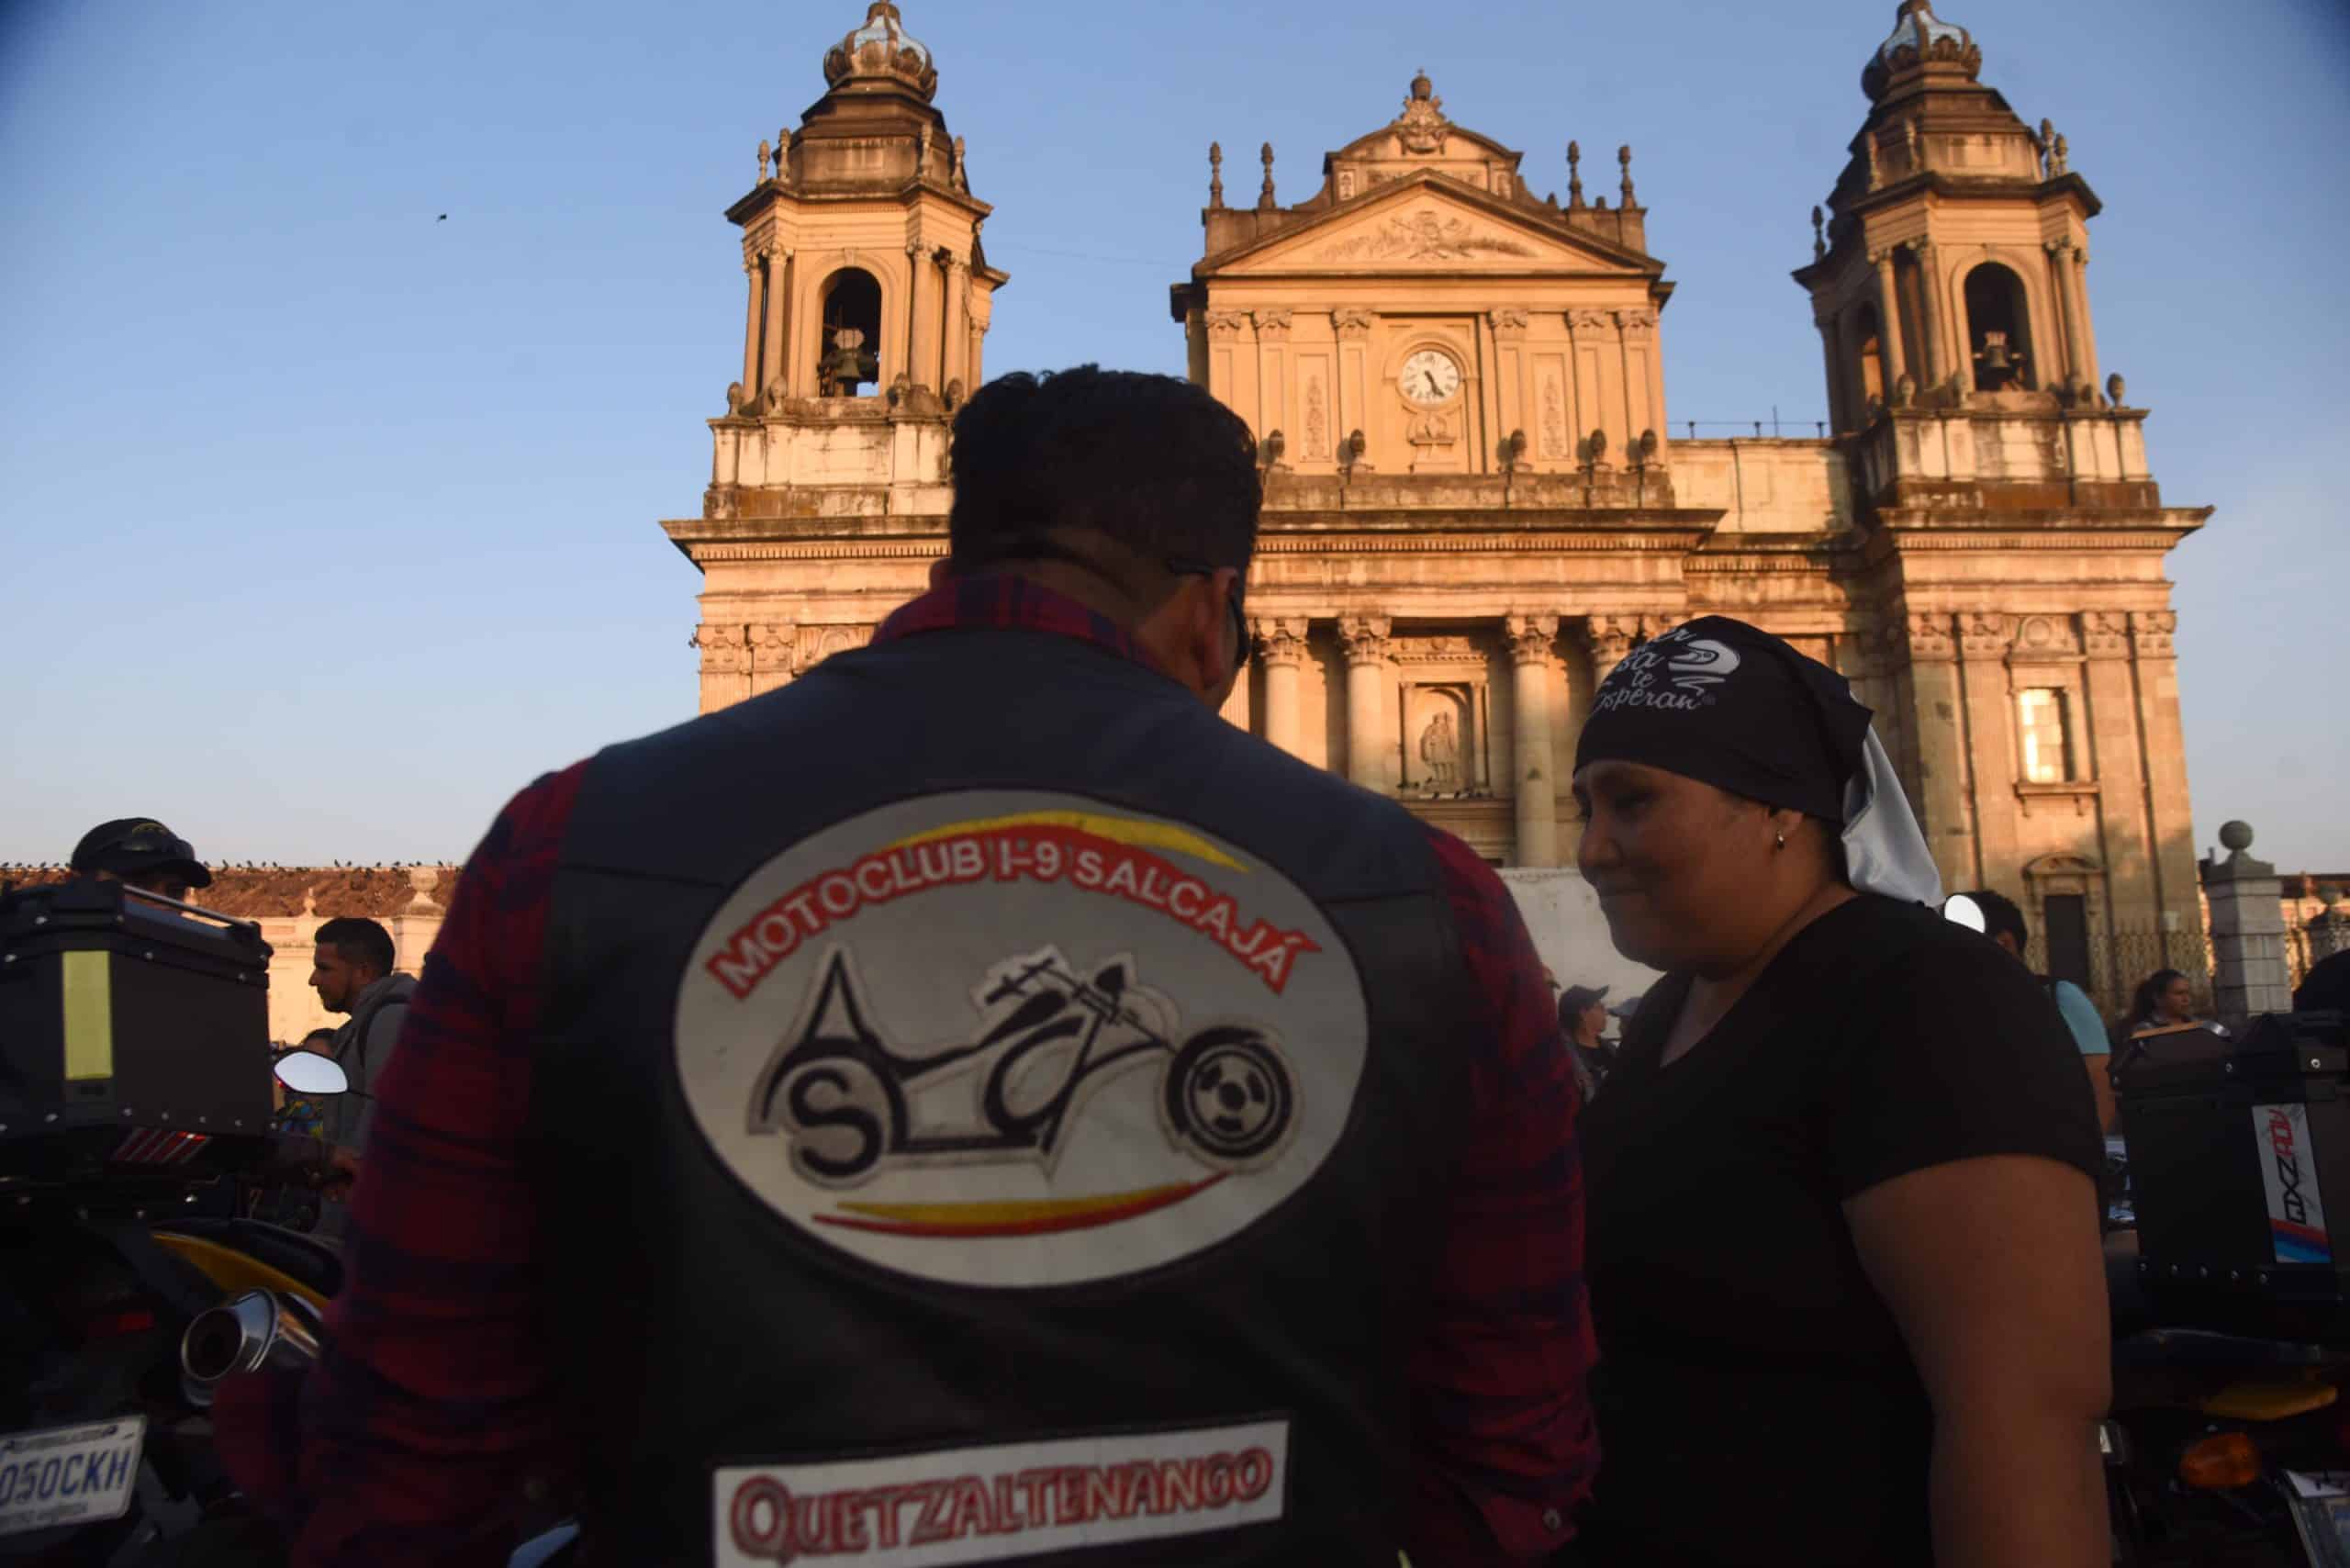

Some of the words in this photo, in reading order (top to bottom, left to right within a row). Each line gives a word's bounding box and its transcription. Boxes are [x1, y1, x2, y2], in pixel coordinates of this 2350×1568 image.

[1630, 670, 1659, 689] te
[716, 837, 986, 991] MOTOCLUB
[999, 837, 1061, 878] I-9
[1075, 850, 1303, 983] SALCAJÁ
